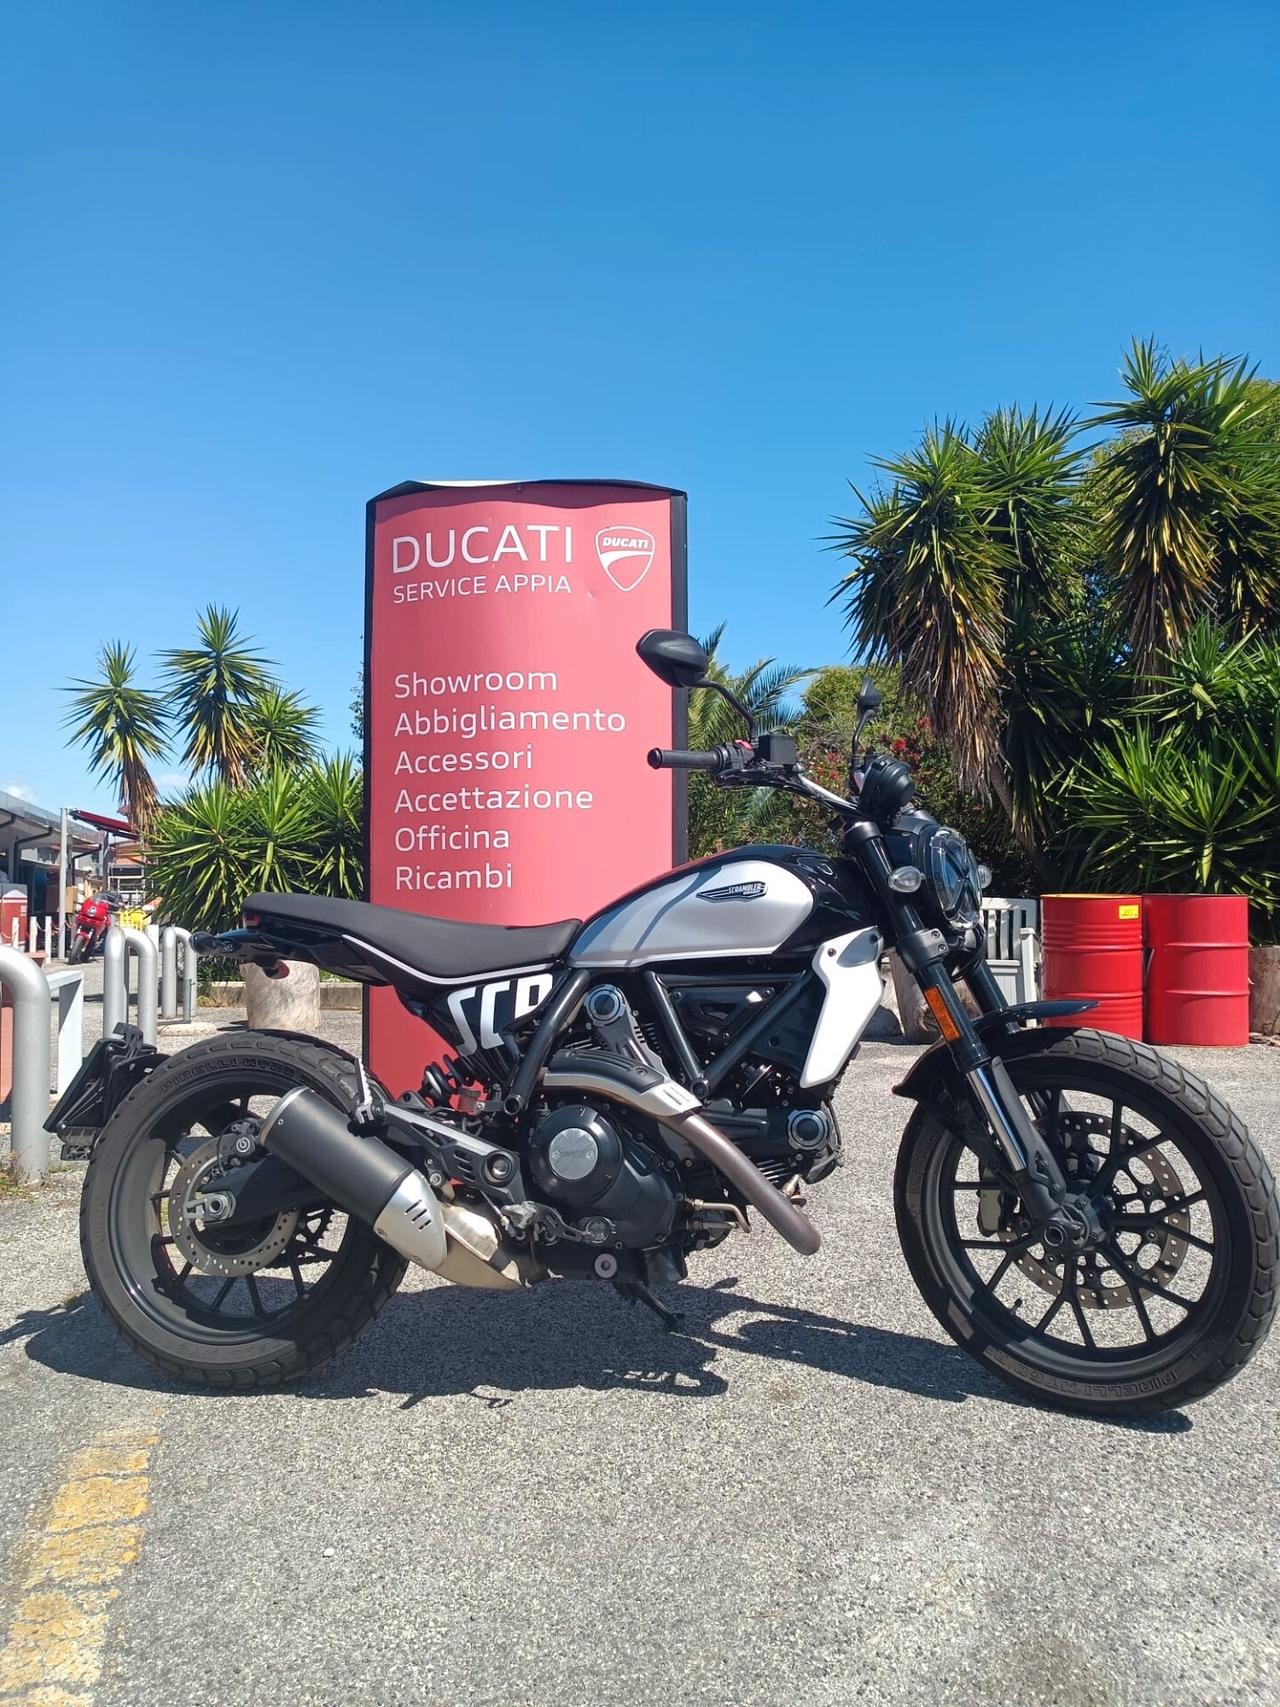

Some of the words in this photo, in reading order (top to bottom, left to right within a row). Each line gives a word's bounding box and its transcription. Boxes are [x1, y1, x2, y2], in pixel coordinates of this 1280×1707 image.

[392, 525, 573, 574] DUCATI
[602, 536, 649, 549] DUCATI
[393, 576, 487, 604] SERVICE
[495, 574, 572, 593] APPIA
[394, 670, 558, 699] Showroom
[394, 705, 626, 739] Abbigliamento
[394, 744, 533, 775] Accessori
[394, 784, 594, 813] Accettazione
[394, 825, 510, 852] Officina
[395, 863, 513, 890] Ricambi
[1084, 1369, 1180, 1398] PIRELLI
